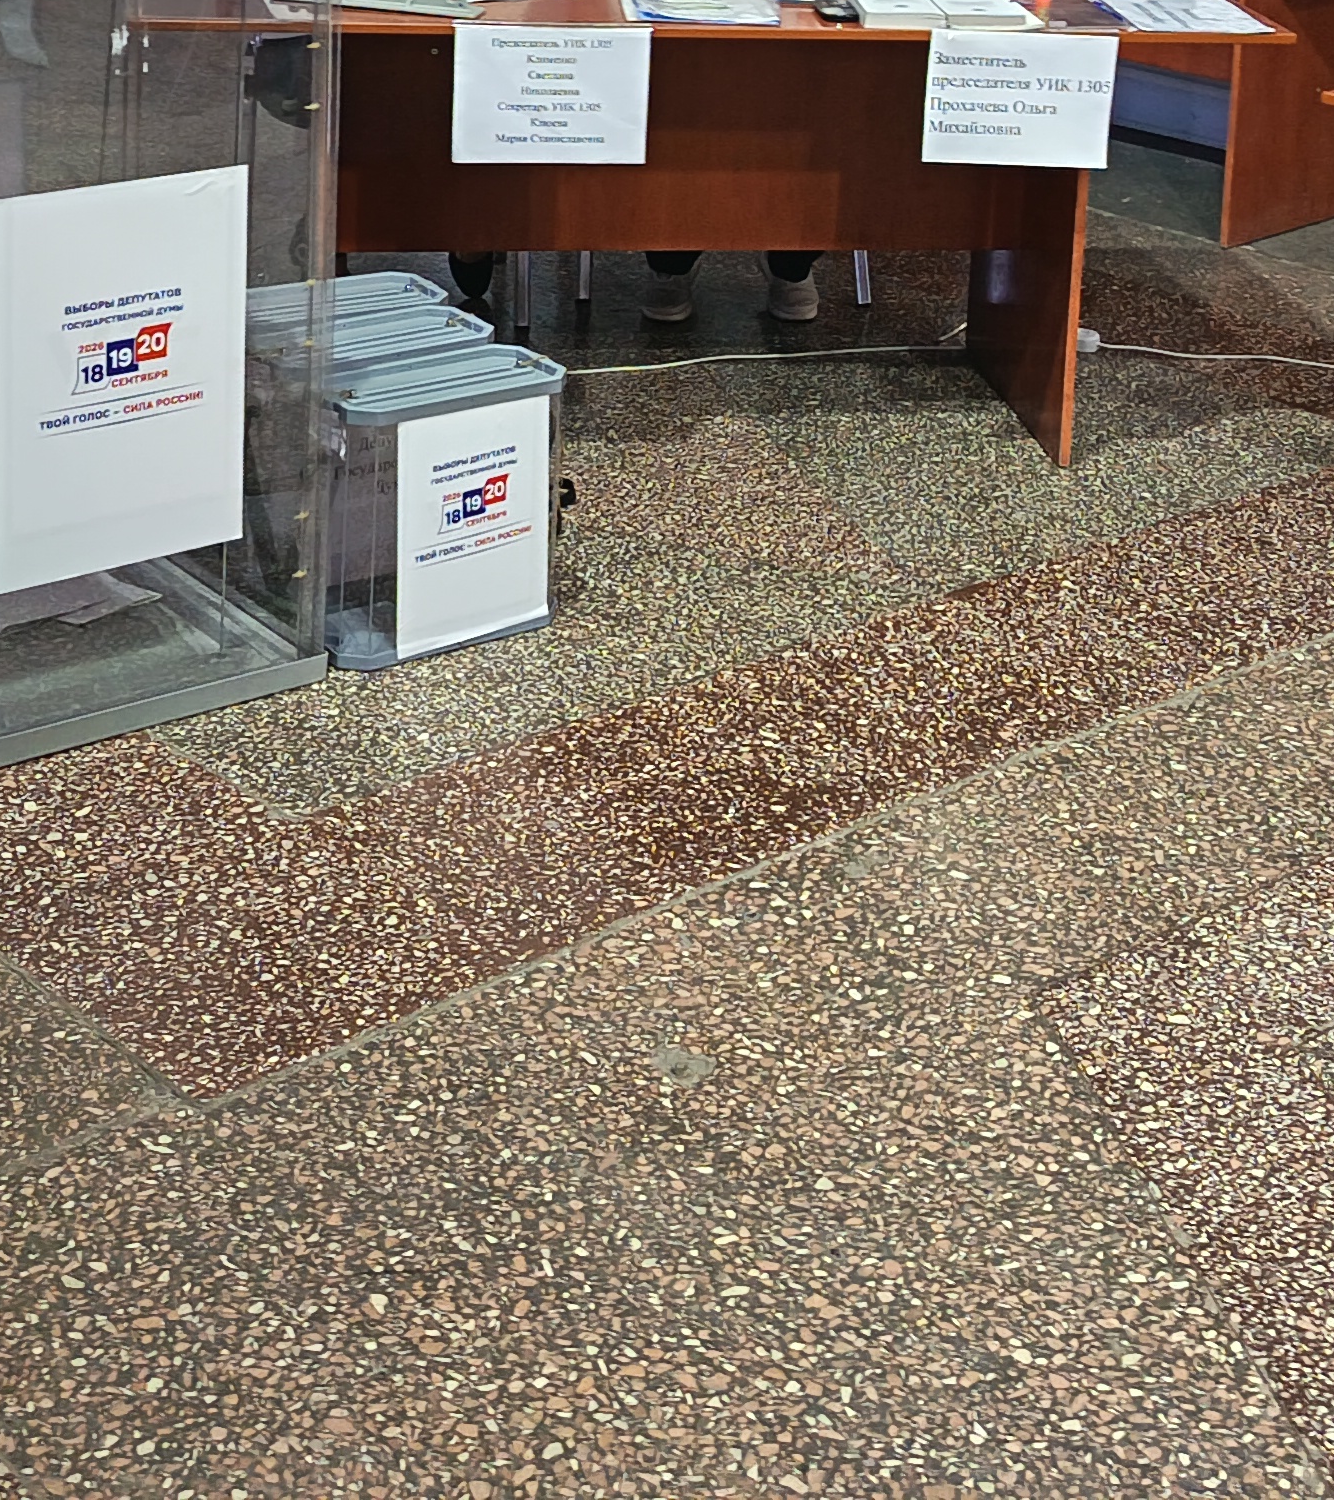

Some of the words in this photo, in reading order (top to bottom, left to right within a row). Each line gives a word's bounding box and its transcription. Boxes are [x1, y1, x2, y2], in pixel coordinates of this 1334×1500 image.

[934, 50, 1027, 69] Заместитель
[931, 76, 1031, 91] председателя
[1035, 77, 1072, 92] УИК
[1076, 79, 1111, 95] 1305
[929, 96, 1009, 115] Прохачева
[1012, 100, 1057, 115] Ольга
[928, 119, 1022, 136] Михайловна
[64, 299, 115, 315] ВЫБОРЫ
[117, 288, 182, 308] ДЕПУТАТОВ
[61, 307, 155, 331] ГОСУДАРСТВЕННОЙ
[155, 303, 184, 316] ДУМЫ
[78, 341, 104, 354] 2026
[81, 364, 104, 385] 18
[109, 347, 133, 369] 19
[137, 332, 166, 355] 20
[111, 369, 168, 388] СЕНТЯБРЯ
[38, 415, 70, 430] ТВОЙ
[72, 408, 110, 423] ГОЛОС
[123, 401, 154, 414] СИЛА
[155, 390, 204, 408] РОССИИ!
[433, 457, 469, 473] ВЫБОРЫ
[470, 445, 516, 464] ДЕПУТАТОВ
[444, 509, 461, 526] 18
[465, 495, 482, 512] 19
[485, 481, 505, 500] 20
[466, 510, 508, 527] СЕНТЯБРЯ
[414, 550, 437, 563] ТВОЙ
[438, 544, 465, 556] ГОЛОС
[474, 536, 496, 547] СИЛА
